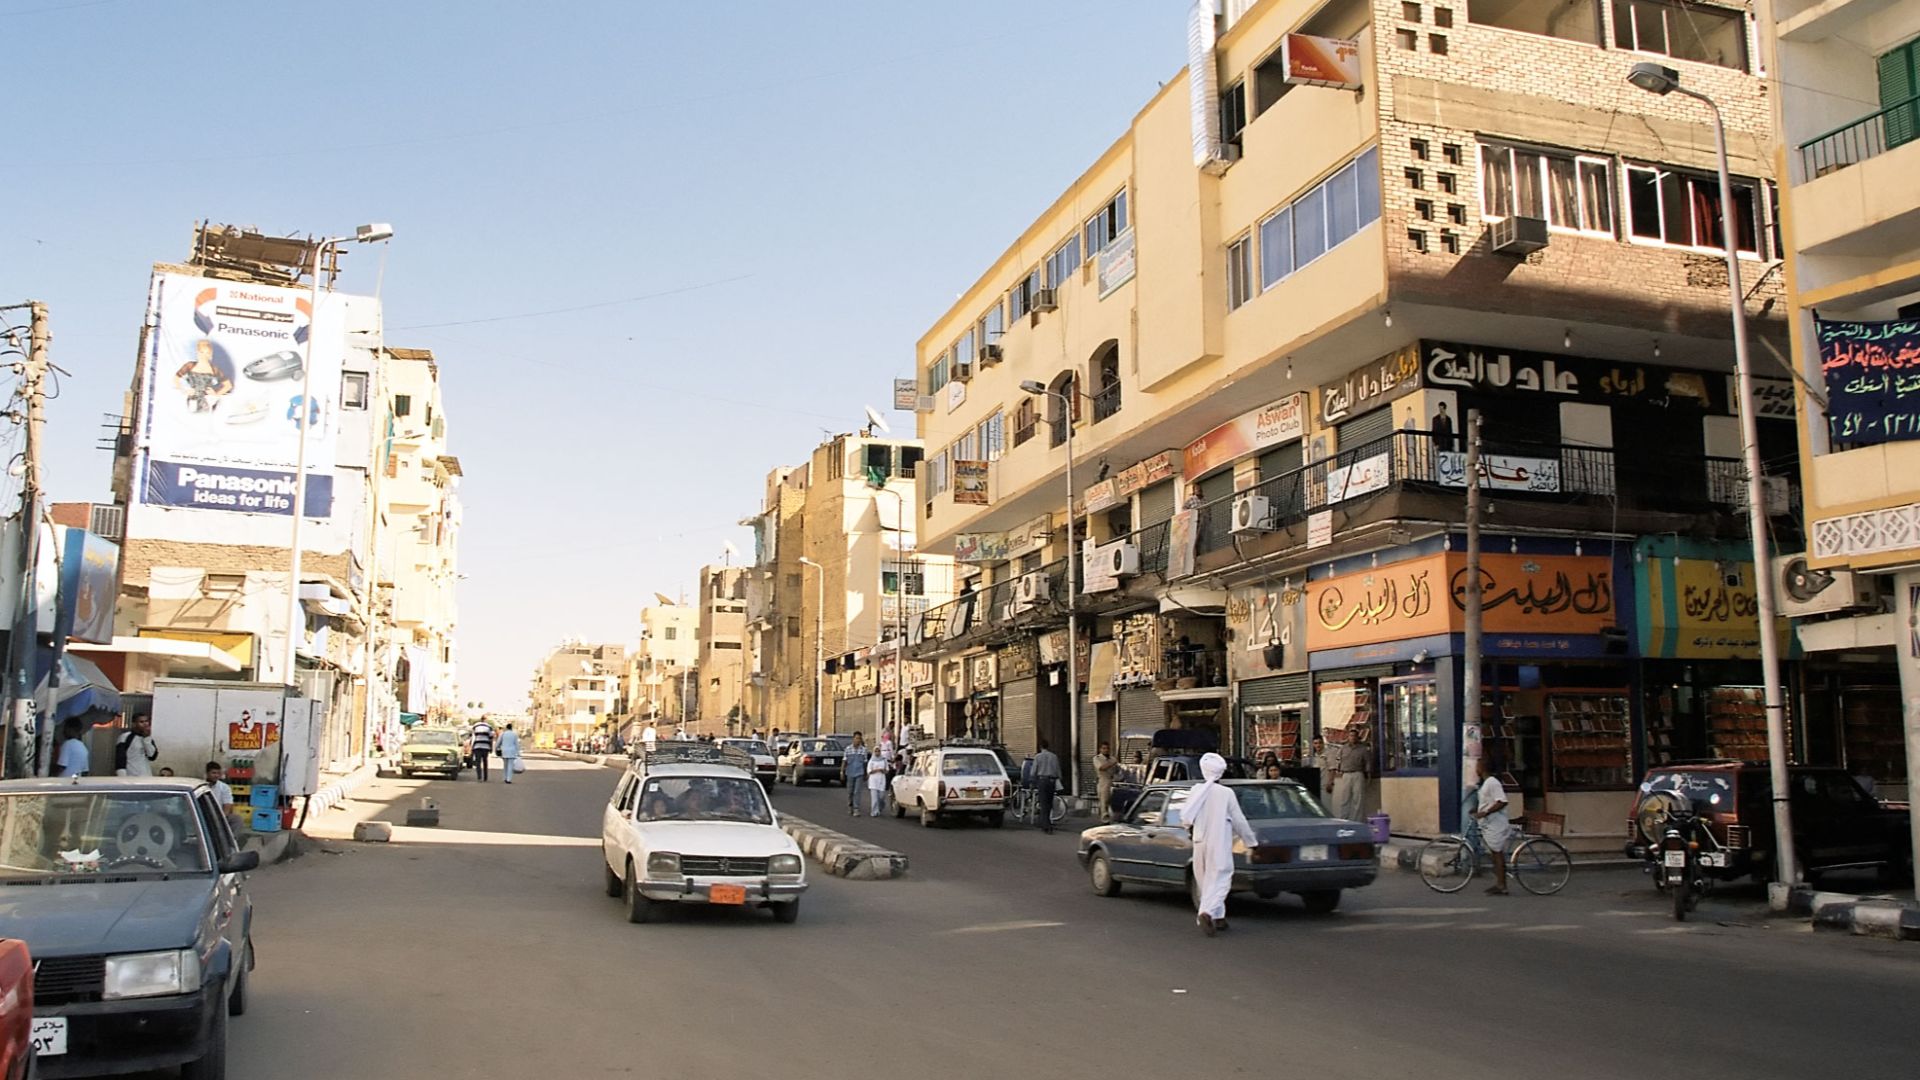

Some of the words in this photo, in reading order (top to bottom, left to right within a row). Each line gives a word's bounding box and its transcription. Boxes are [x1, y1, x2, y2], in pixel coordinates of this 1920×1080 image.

[239, 291, 284, 304] National
[217, 322, 290, 340] Panasonic
[1358, 366, 1397, 401] عادل
[1486, 354, 1580, 395] عادل
[1256, 405, 1297, 429] Aswan
[1256, 427, 1279, 441] Photo
[1280, 419, 1300, 434] Club
[194, 489, 236, 506] ideas
[238, 491, 263, 507] for
[264, 495, 290, 509] life
